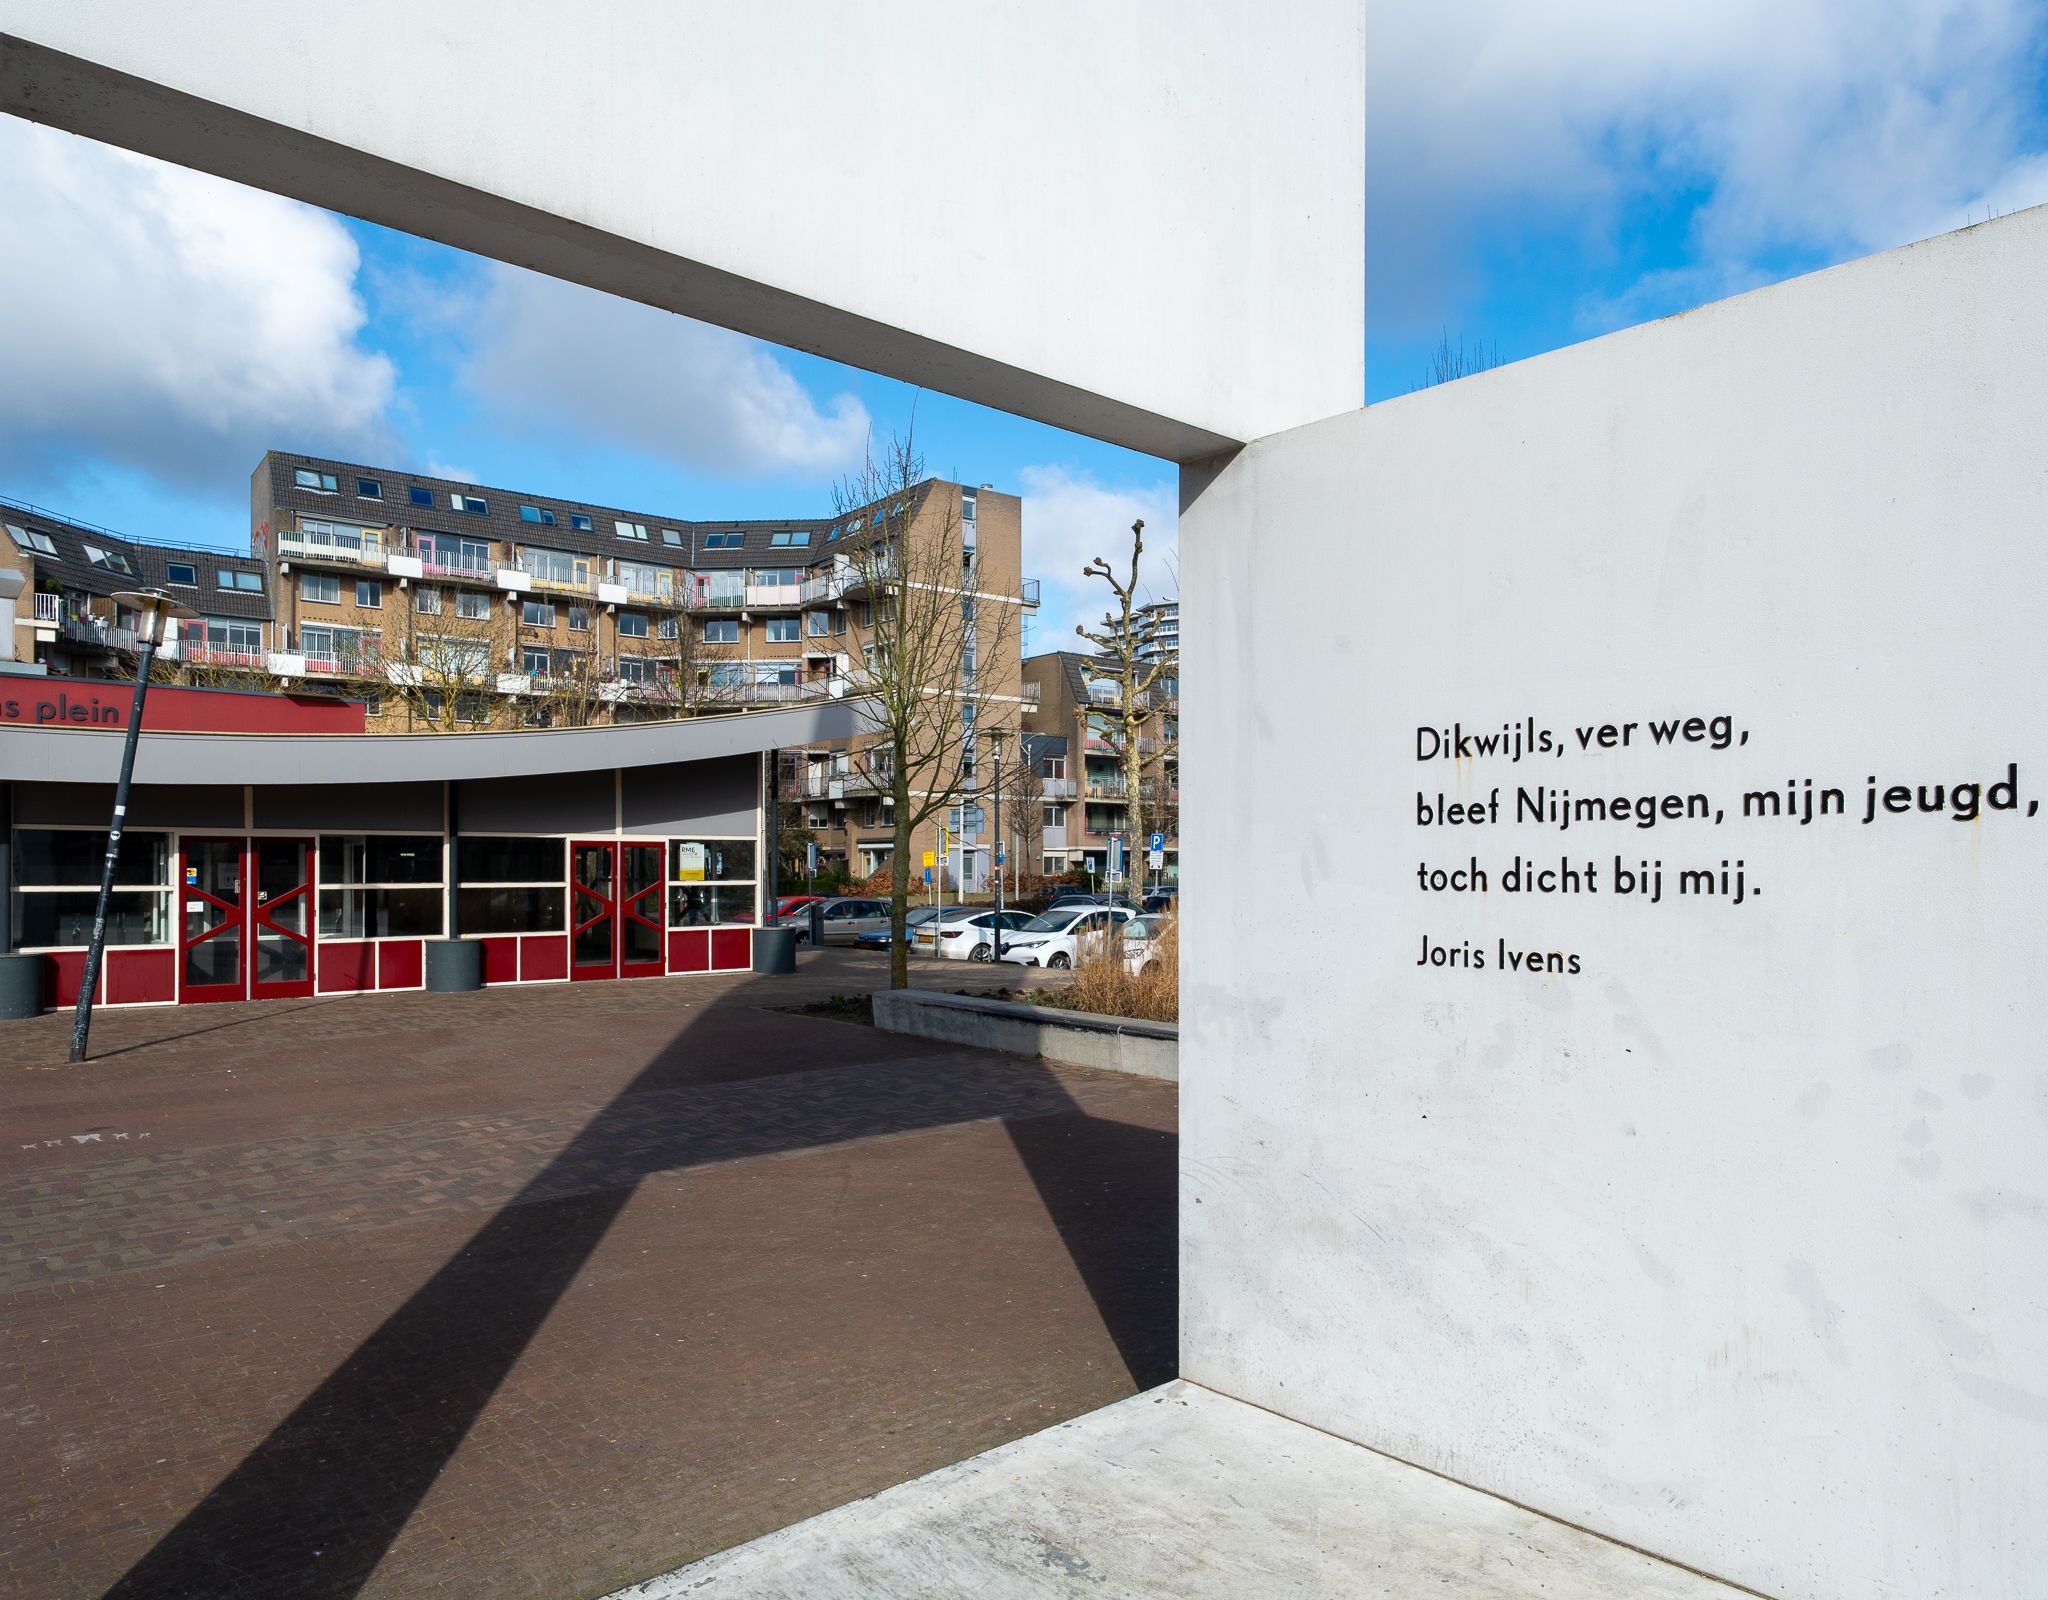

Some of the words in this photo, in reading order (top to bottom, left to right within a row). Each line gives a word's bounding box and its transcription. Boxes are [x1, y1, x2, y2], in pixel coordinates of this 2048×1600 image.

[0, 699, 20, 718] s
[37, 692, 119, 724] plein
[1416, 716, 1565, 763] Dikwijls,
[1575, 721, 1639, 751] ver
[1648, 715, 1750, 750] weg,
[1416, 787, 1499, 826] bleef
[1517, 786, 1725, 831] Nijmegen,
[1743, 778, 1845, 826] mijn
[1862, 762, 2040, 823] jeugd,
[1153, 835, 1161, 850] P
[1416, 856, 1488, 892] toch
[1501, 855, 1598, 894] dicht
[1614, 855, 1662, 904] bij
[1680, 859, 1762, 905] mij.
[1416, 934, 1485, 969] Joris
[1499, 938, 1581, 975] Ivens
